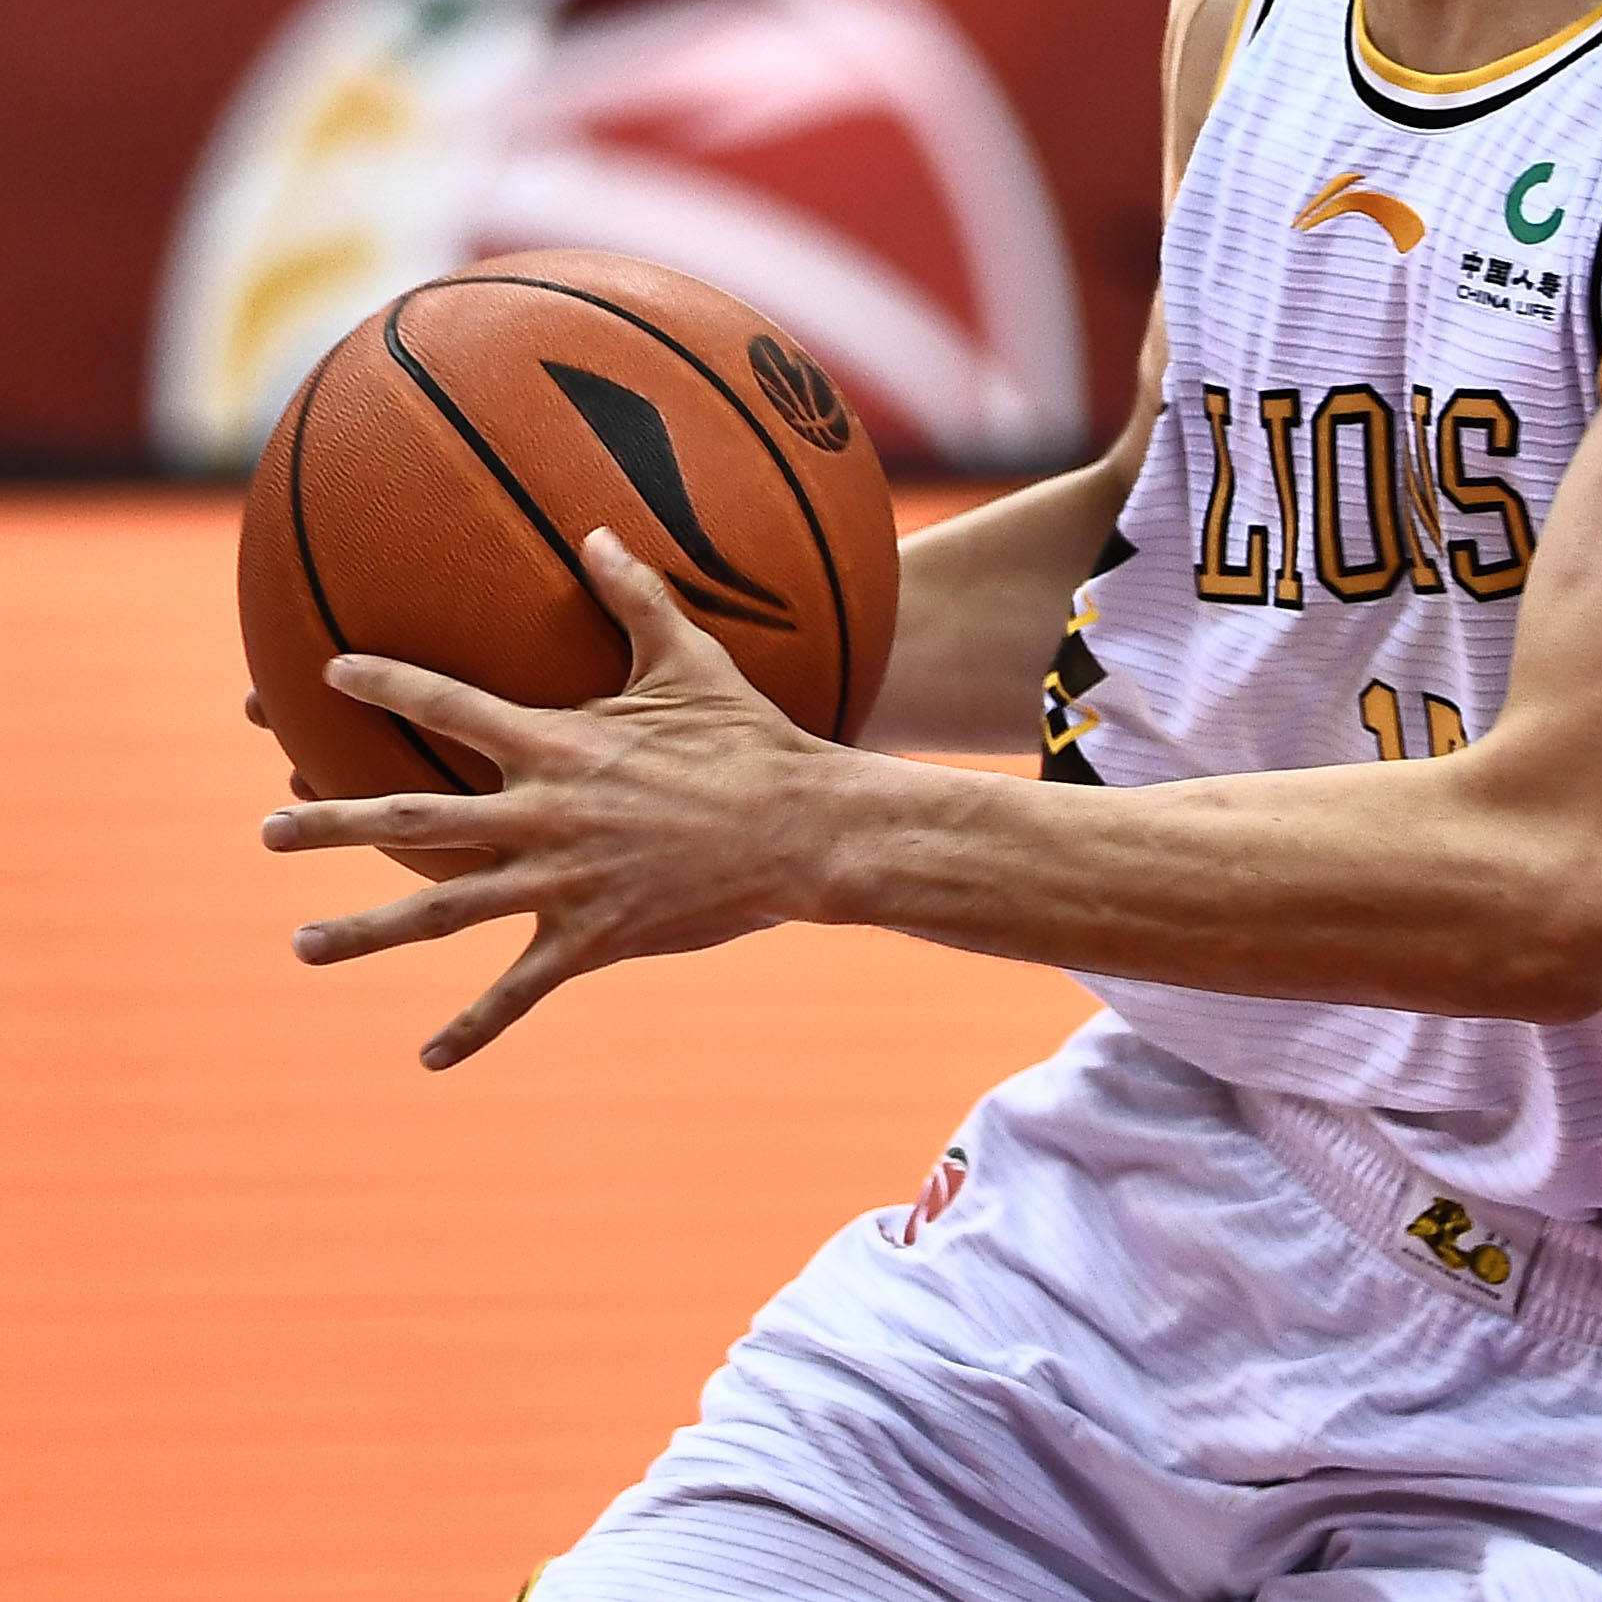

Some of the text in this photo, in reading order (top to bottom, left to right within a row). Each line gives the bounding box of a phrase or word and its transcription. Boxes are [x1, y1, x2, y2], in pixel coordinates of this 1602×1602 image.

[1460, 251, 1561, 298] 中国人寿
[1457, 284, 1511, 311] CHINA
